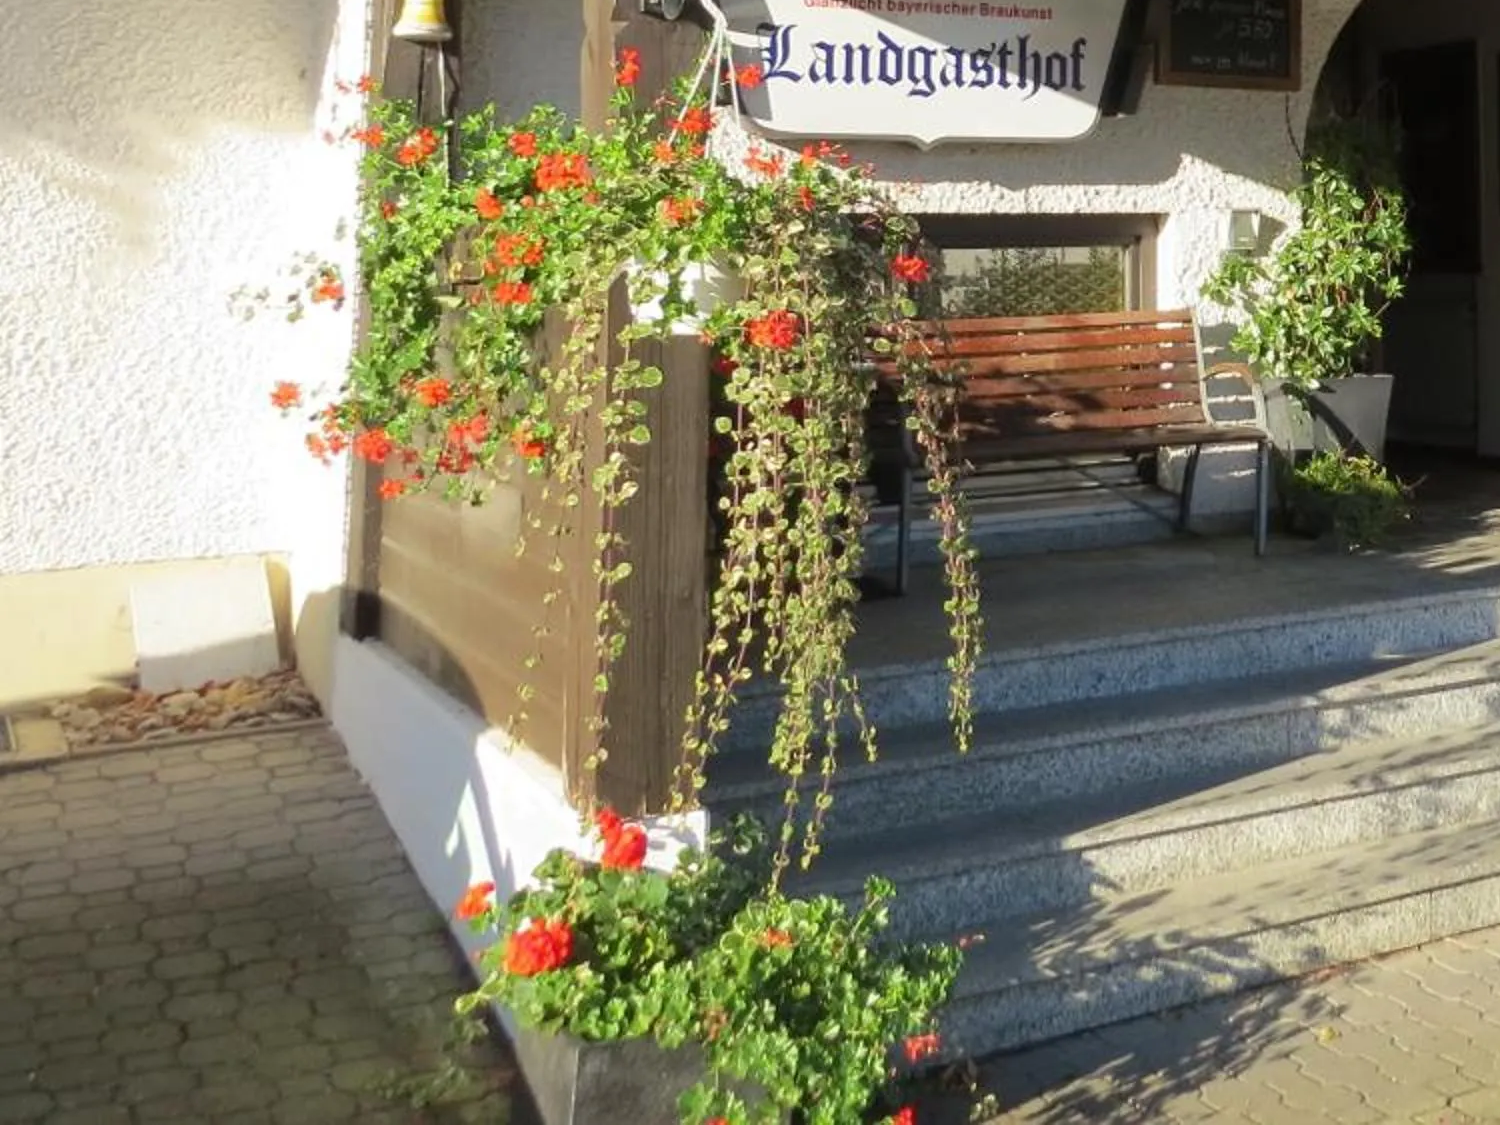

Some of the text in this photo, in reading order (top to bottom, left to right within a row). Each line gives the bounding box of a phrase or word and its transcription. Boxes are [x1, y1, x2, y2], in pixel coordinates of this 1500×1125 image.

[886, 0, 975, 18] bayerischer
[980, 3, 1053, 20] Braukunst
[755, 21, 1087, 100] Landgasthof
